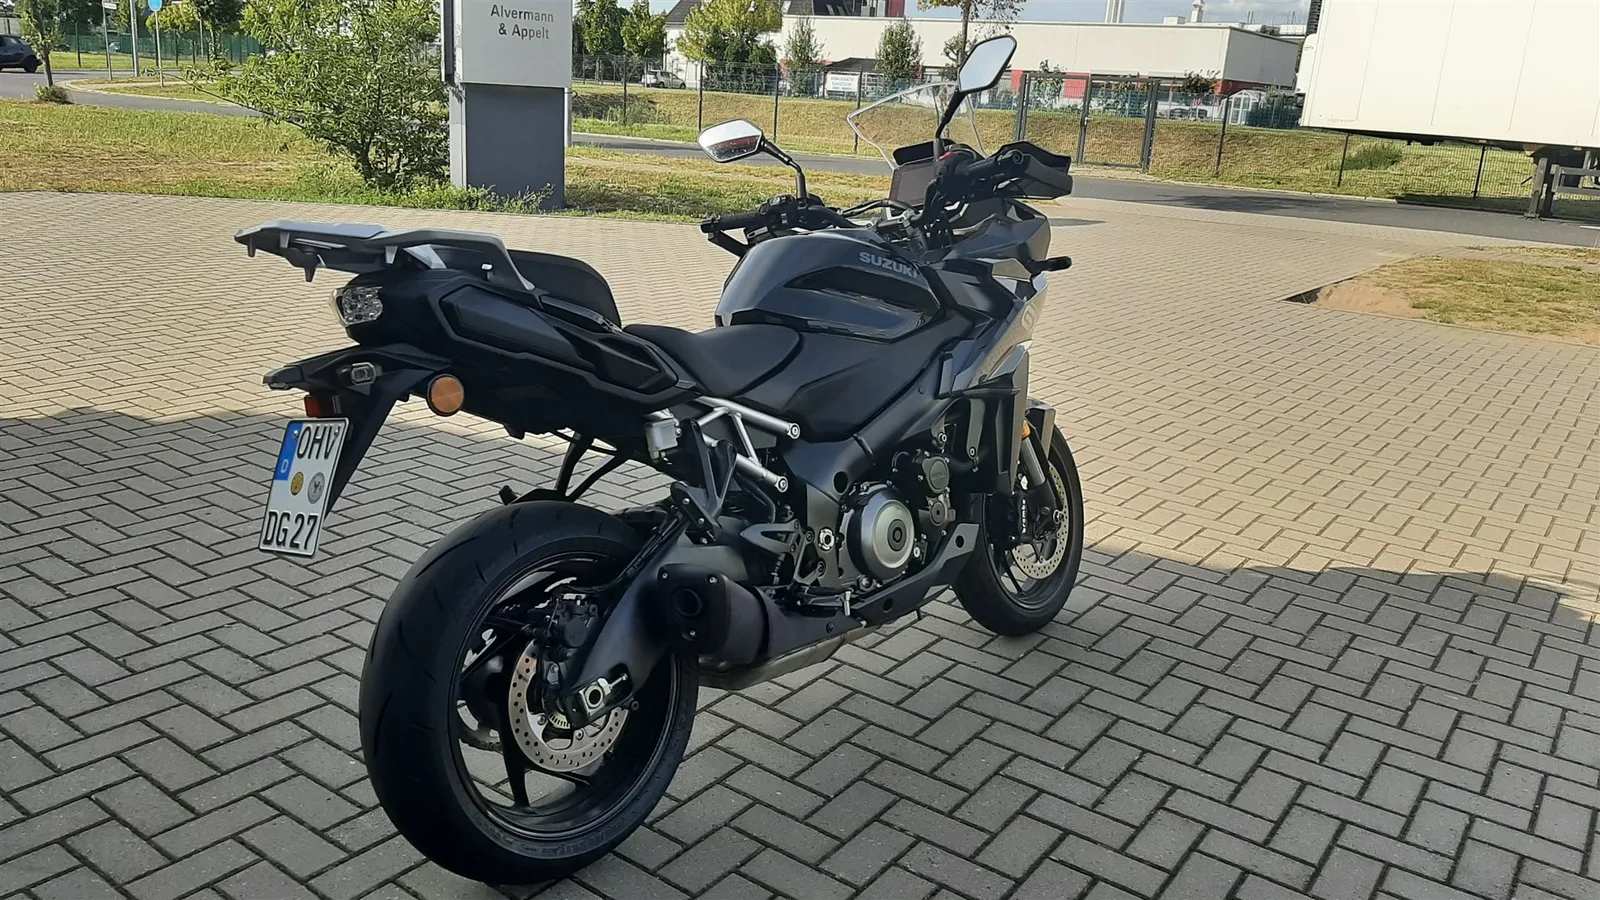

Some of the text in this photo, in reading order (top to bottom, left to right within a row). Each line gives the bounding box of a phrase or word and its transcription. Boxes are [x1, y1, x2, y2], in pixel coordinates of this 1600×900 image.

[490, 4, 554, 23] Alvermann
[498, 22, 550, 40] & Appelt
[859, 251, 918, 279] SUZUKI
[297, 425, 341, 460] OHV
